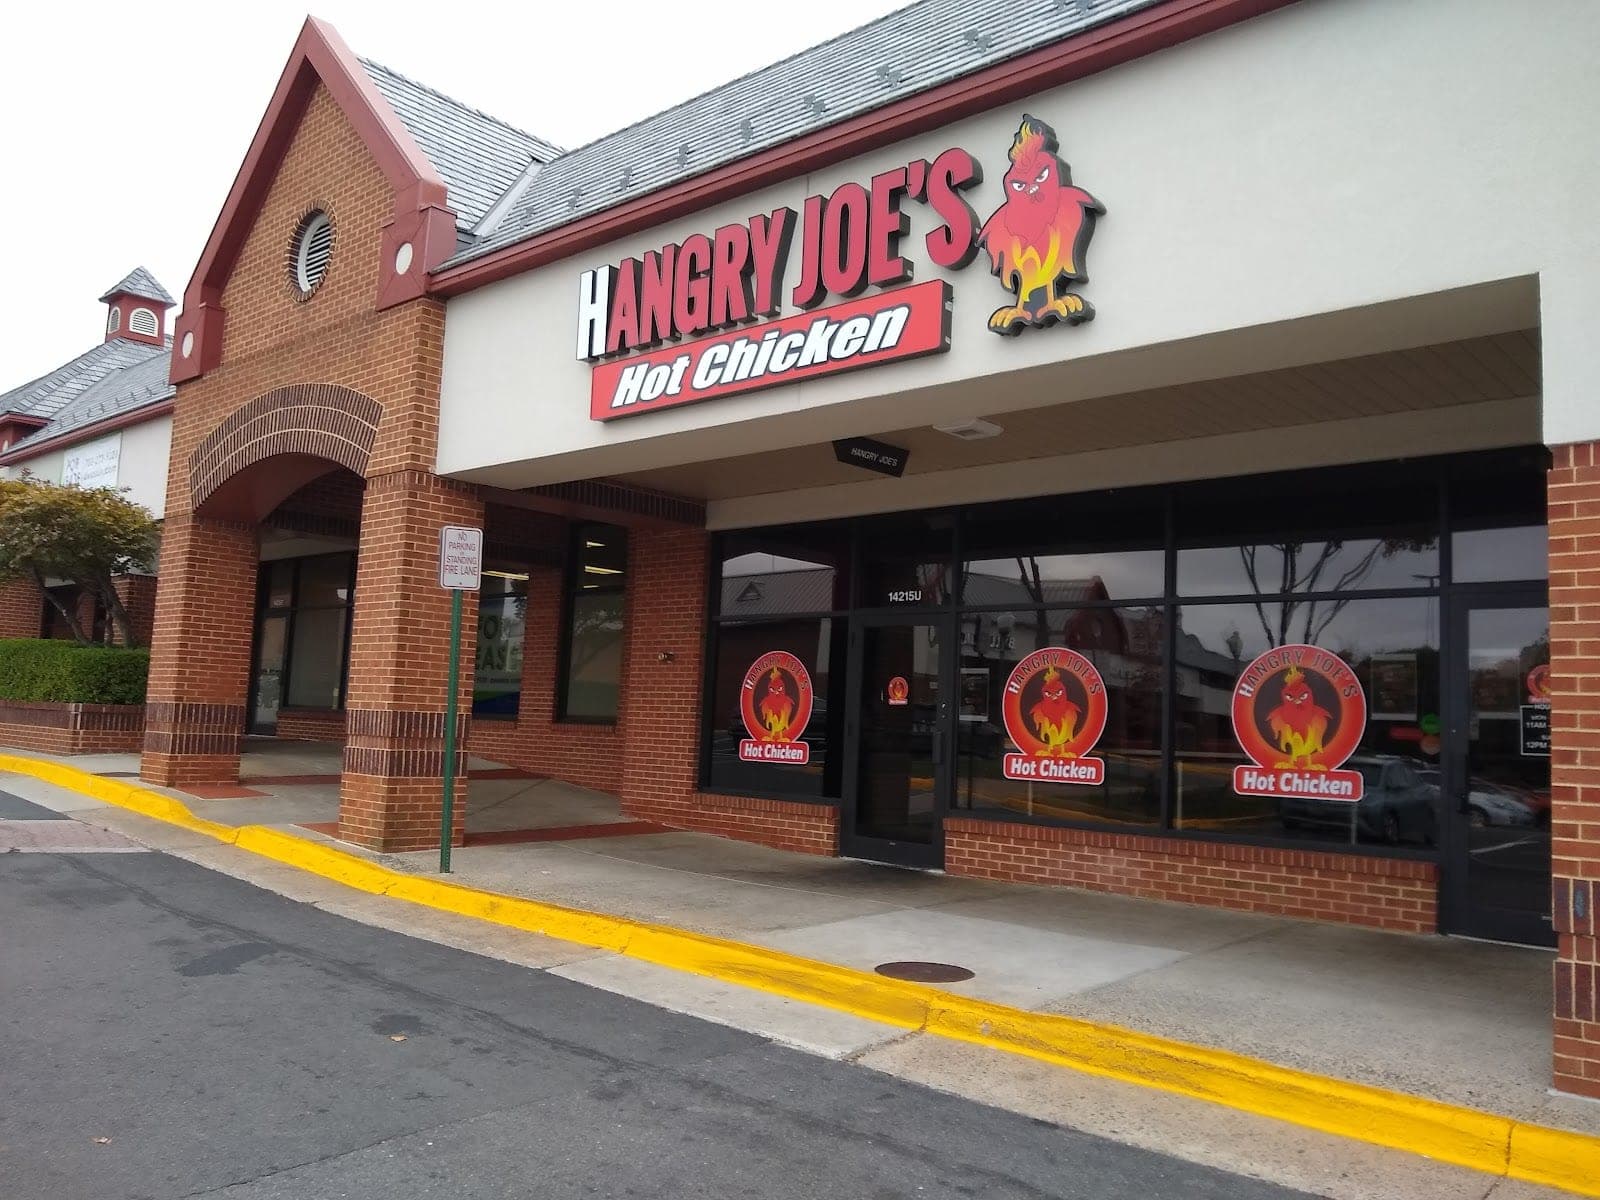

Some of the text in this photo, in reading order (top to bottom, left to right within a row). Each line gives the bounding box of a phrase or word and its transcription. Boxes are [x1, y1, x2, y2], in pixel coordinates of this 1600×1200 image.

[576, 147, 979, 361] HANGRY JOE'S
[611, 304, 910, 409] Hot Chicken
[851, 447, 879, 461] HANGRY
[449, 541, 476, 551] PARKING
[458, 532, 467, 541] NO
[446, 555, 478, 565] STANDING
[444, 564, 478, 576] FIRE LANE
[888, 590, 922, 602] 14215U
[744, 654, 782, 690] HANGRY
[1008, 652, 1101, 695] HANGRY JOE'S
[1238, 650, 1358, 698] HANGRY JOE'S
[745, 743, 804, 760] Hot Chicken
[1011, 758, 1097, 780] Hot Chicken
[1242, 770, 1354, 796] Hot Chicken
